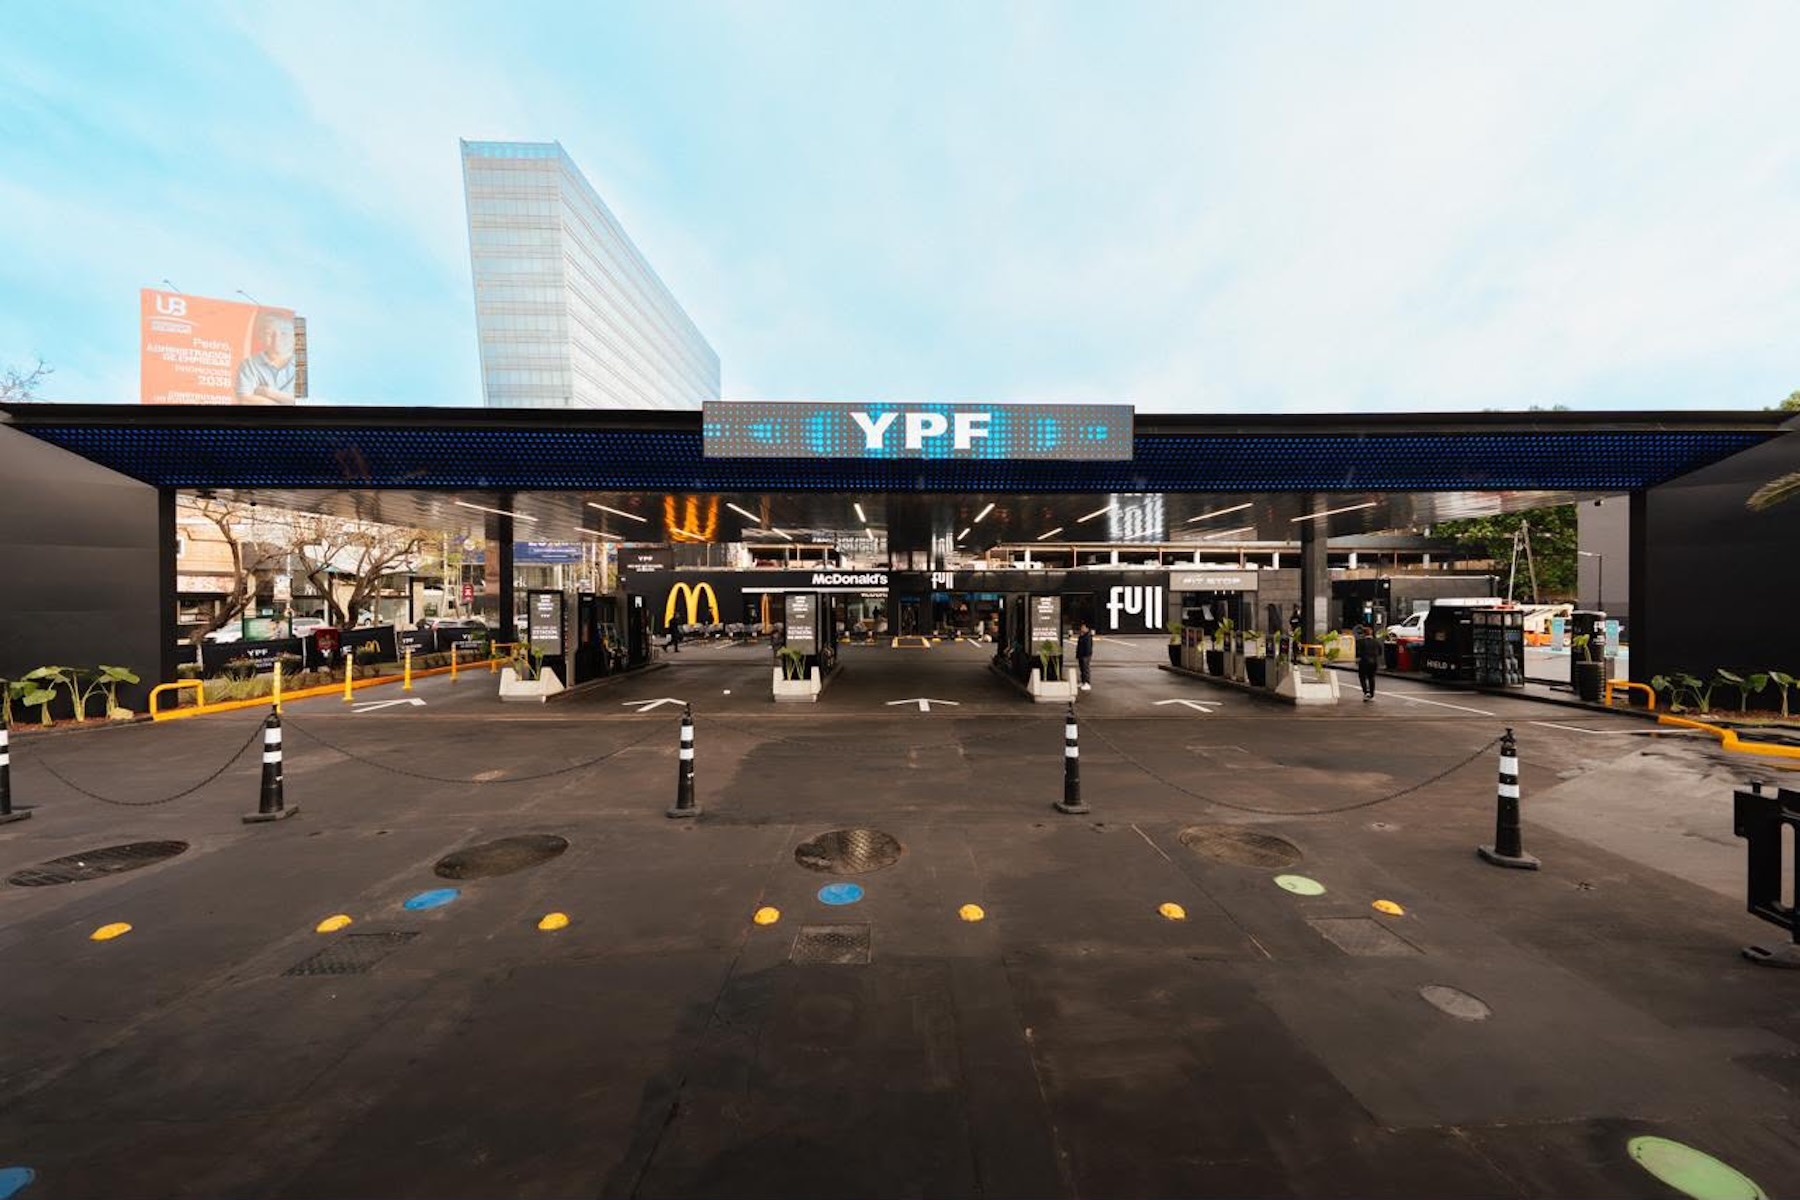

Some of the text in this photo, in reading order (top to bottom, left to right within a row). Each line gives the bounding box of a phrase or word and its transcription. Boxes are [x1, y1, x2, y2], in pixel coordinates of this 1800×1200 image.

[156, 294, 187, 317] UB
[849, 412, 992, 450] YPF
[812, 573, 888, 585] McDonald's
[931, 572, 954, 589] full
[1106, 586, 1163, 629] full
[247, 648, 269, 657] YPF
